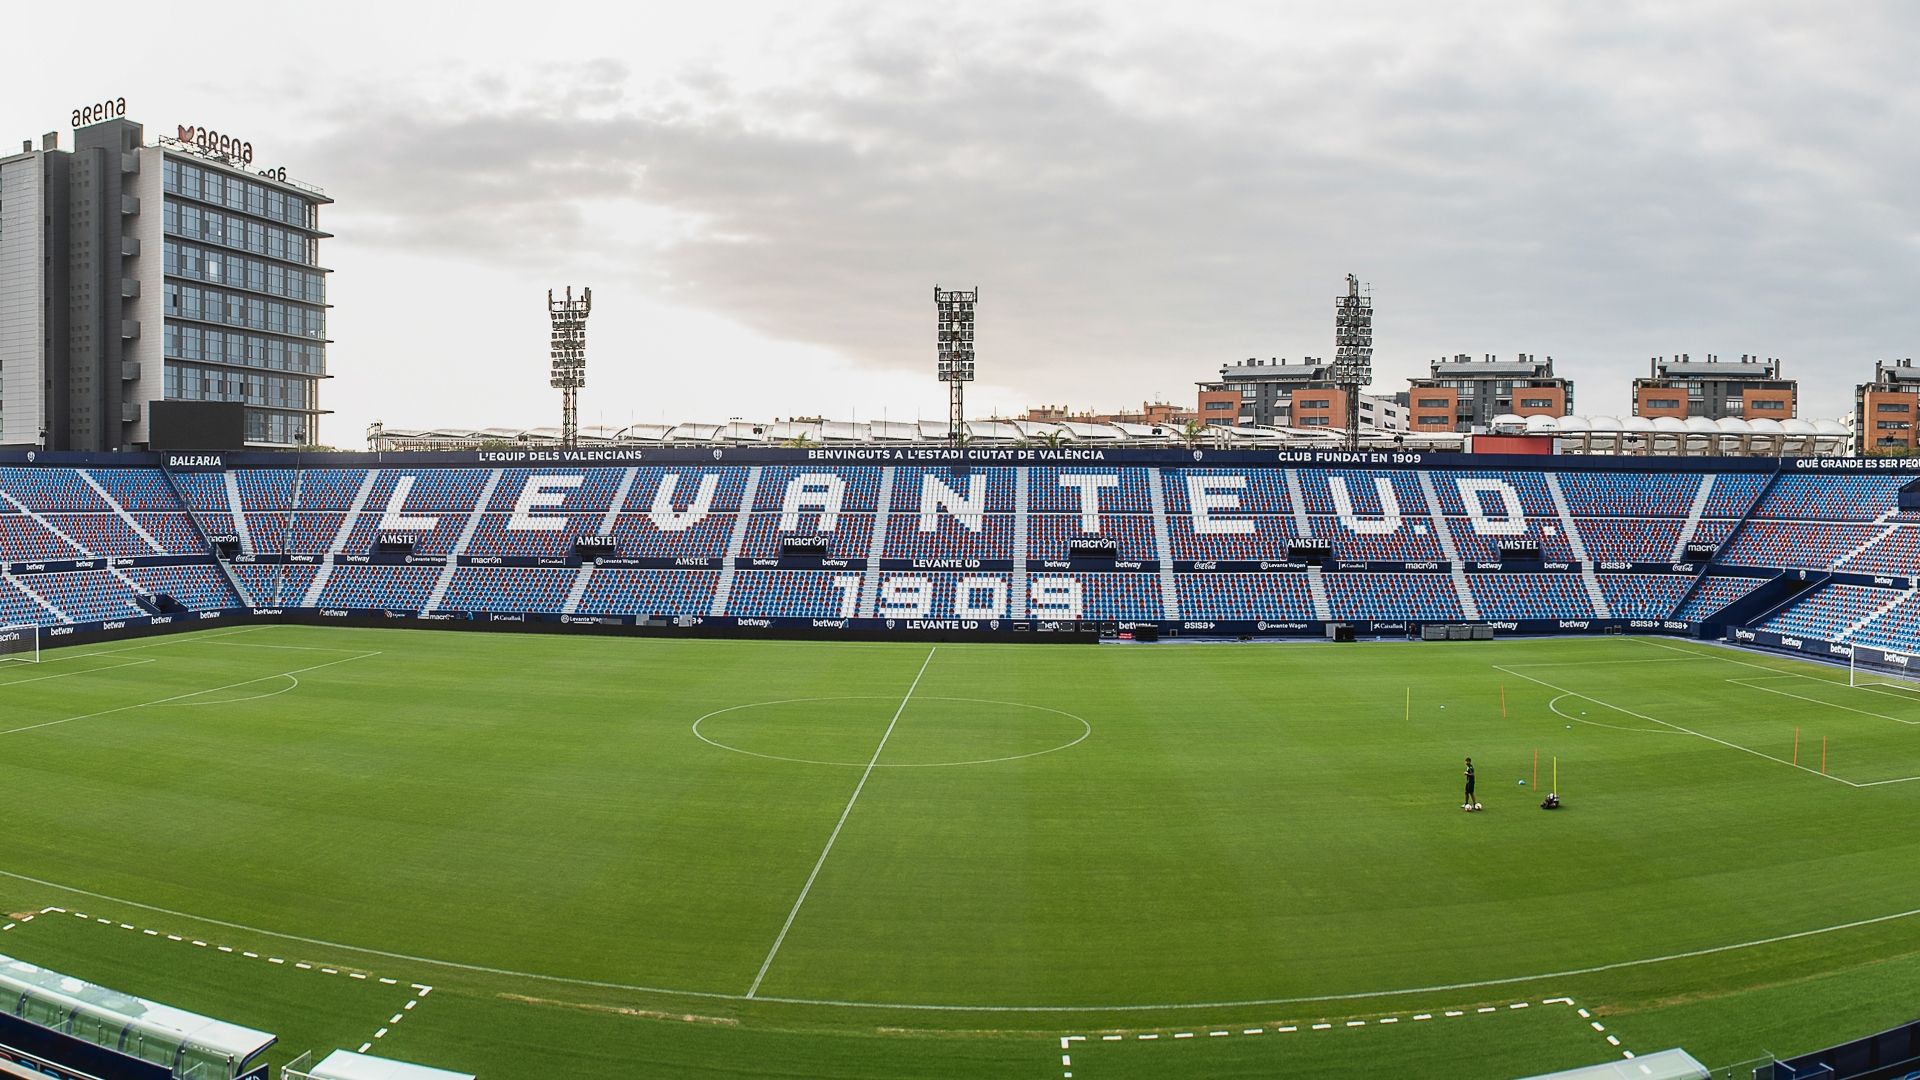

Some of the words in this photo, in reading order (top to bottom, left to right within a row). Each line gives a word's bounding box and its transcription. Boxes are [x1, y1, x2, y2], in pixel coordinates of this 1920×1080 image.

[479, 451, 526, 462] L'EQUIP
[529, 451, 560, 461] DELS
[563, 450, 642, 461] VALENCIANS
[808, 449, 890, 460] BENVINGUTS
[894, 449, 904, 460] A
[907, 449, 964, 460] L'ESTADI
[968, 449, 1014, 460] CIUTAT
[1017, 449, 1035, 460] DE
[1039, 448, 1104, 460] VALÈNCIA
[1278, 452, 1312, 462] CLUB
[1316, 453, 1368, 463] FUNDAT
[1370, 453, 1388, 463] EN
[1392, 453, 1421, 464] 1909
[1796, 457, 1819, 468] QUÉ
[1820, 459, 1863, 468] GRANDE
[1864, 459, 1878, 468] ES
[1879, 459, 1898, 468] SER
[1287, 538, 1330, 548] AMSTEL
[1497, 540, 1539, 550] AMSTEL
[1687, 543, 1718, 552] macro
[290, 554, 314, 562] betway
[346, 554, 370, 562] betway
[675, 557, 709, 566] AMSTEL
[753, 558, 779, 567] betway
[822, 559, 848, 568] betway
[912, 559, 963, 568] LEVANTE
[965, 559, 980, 568] UD
[1044, 560, 1071, 569] betway
[1115, 560, 1141, 569] betway
[1477, 561, 1502, 571] betway
[1544, 561, 1569, 570] betway
[737, 617, 769, 628] betway
[812, 618, 845, 629] betway
[906, 620, 959, 630] LEVANTE
[961, 620, 979, 630] UD
[1290, 622, 1308, 630] Wagen
[1559, 620, 1590, 630] betway
